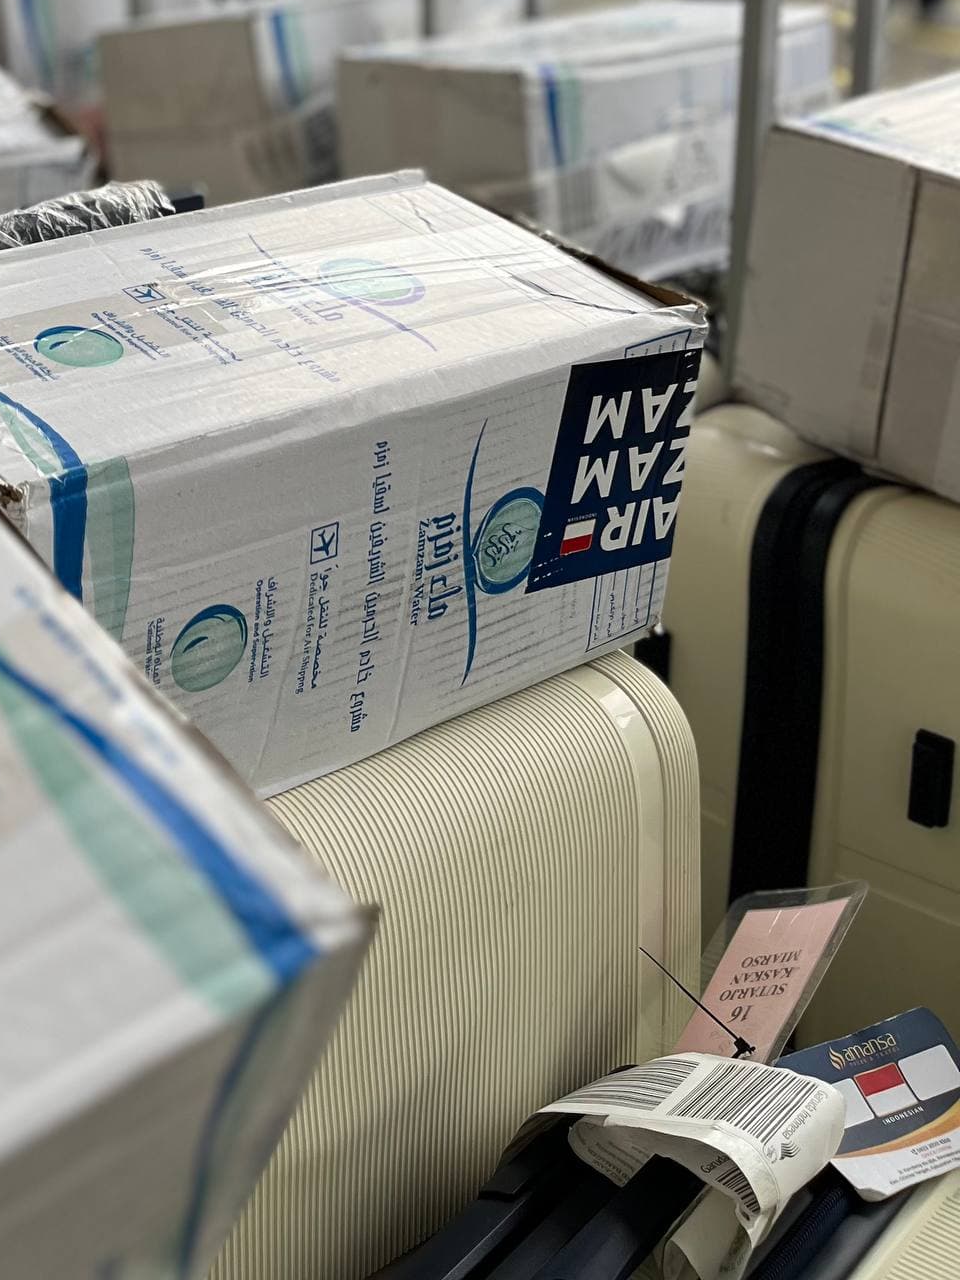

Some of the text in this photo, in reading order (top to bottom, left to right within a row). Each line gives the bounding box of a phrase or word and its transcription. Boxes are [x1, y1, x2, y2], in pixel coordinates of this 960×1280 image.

[570, 436, 689, 505] ZAM
[600, 491, 681, 552] AIR
[350, 440, 392, 733] مشروع خادم الحرمين الشريفين لسقيا زمزم
[410, 518, 430, 626] Zamzam Water
[424, 512, 463, 620] ماء زمزم
[253, 579, 264, 620] Operation
[306, 573, 318, 621] Dedicated
[317, 596, 330, 629] للنقل
[305, 623, 313, 636] for
[259, 632, 274, 678] التشغيل
[311, 631, 329, 689] مخصصة
[729, 966, 793, 985] KASKAN
[741, 949, 802, 969] MIARSO
[719, 983, 788, 1002] SUTARJO
[726, 1005, 754, 1024] 16
[806, 1089, 829, 1112] Garuda
[882, 1105, 924, 1126] INDONESIAN
